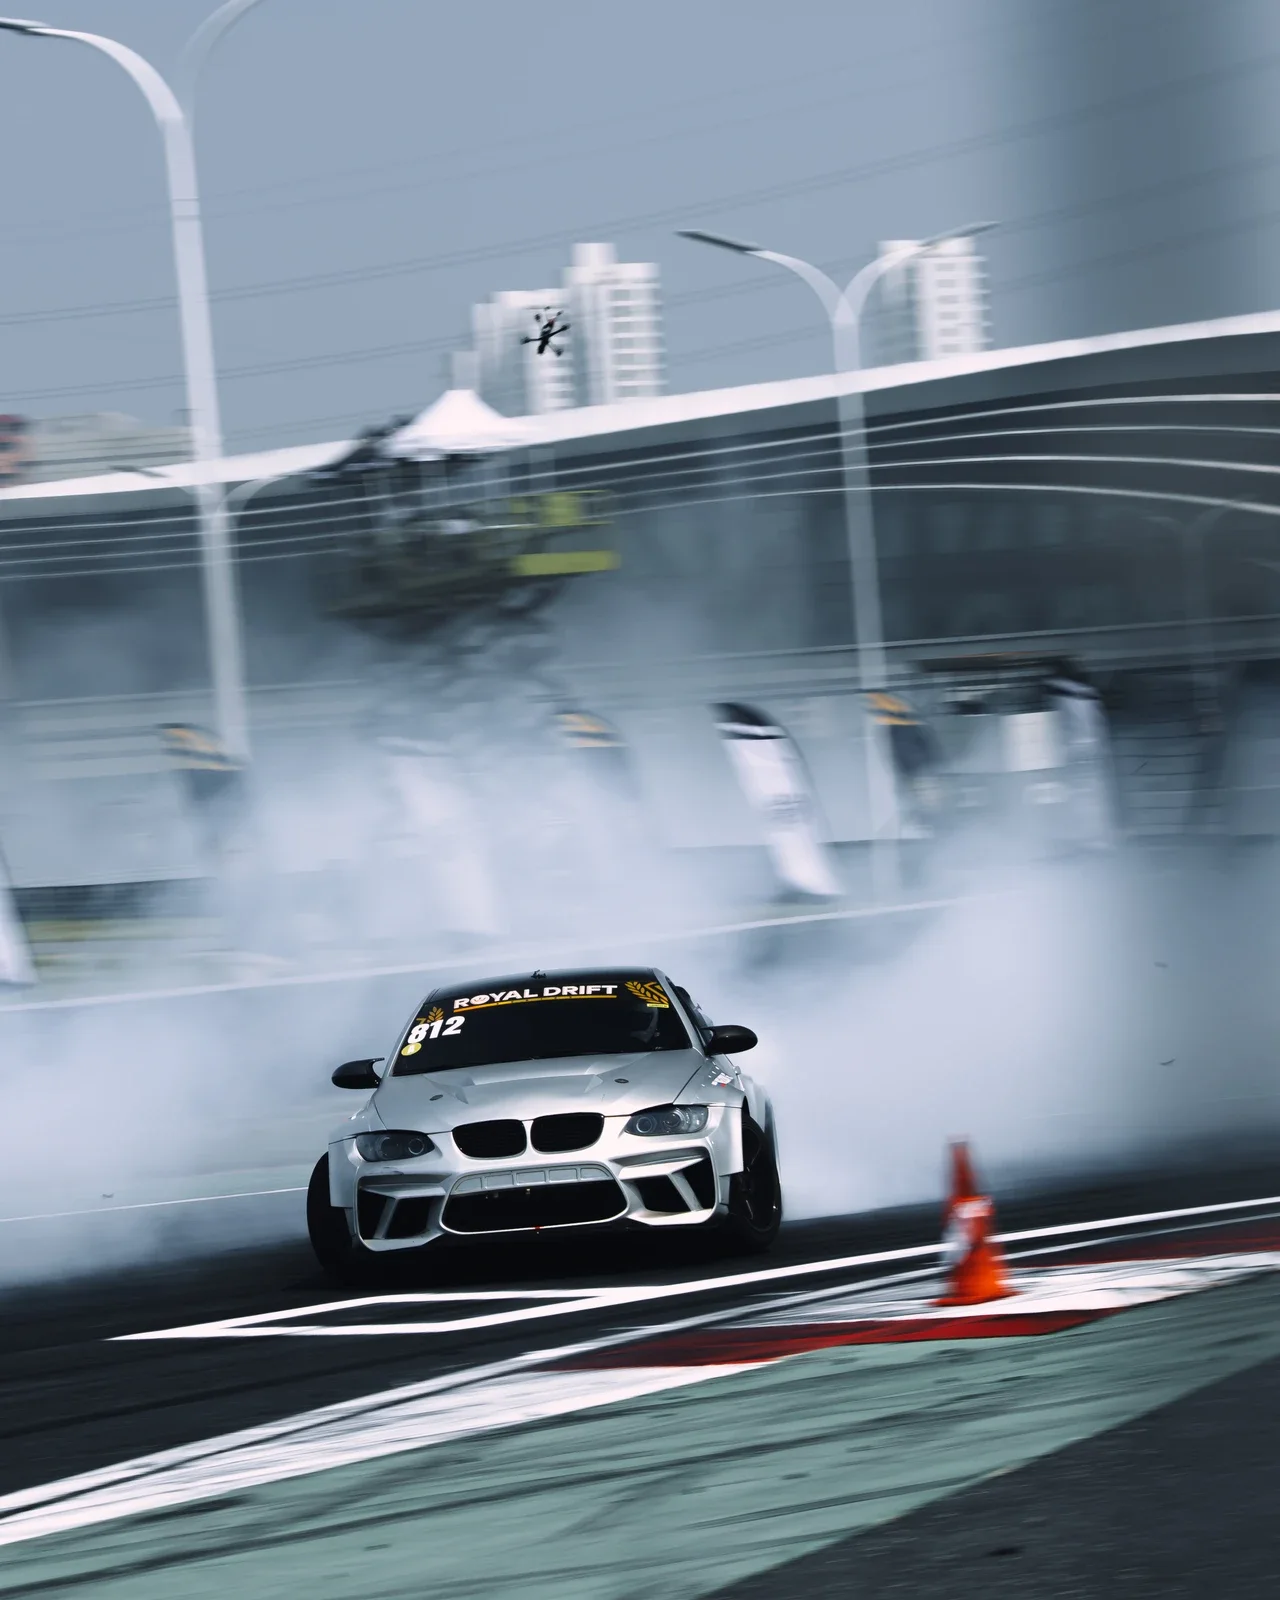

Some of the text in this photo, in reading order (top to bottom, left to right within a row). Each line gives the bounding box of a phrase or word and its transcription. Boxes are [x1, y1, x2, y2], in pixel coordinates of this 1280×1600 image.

[453, 988, 539, 1009] ROYAL
[543, 985, 618, 997] DRIFT
[407, 1015, 466, 1044] 812
